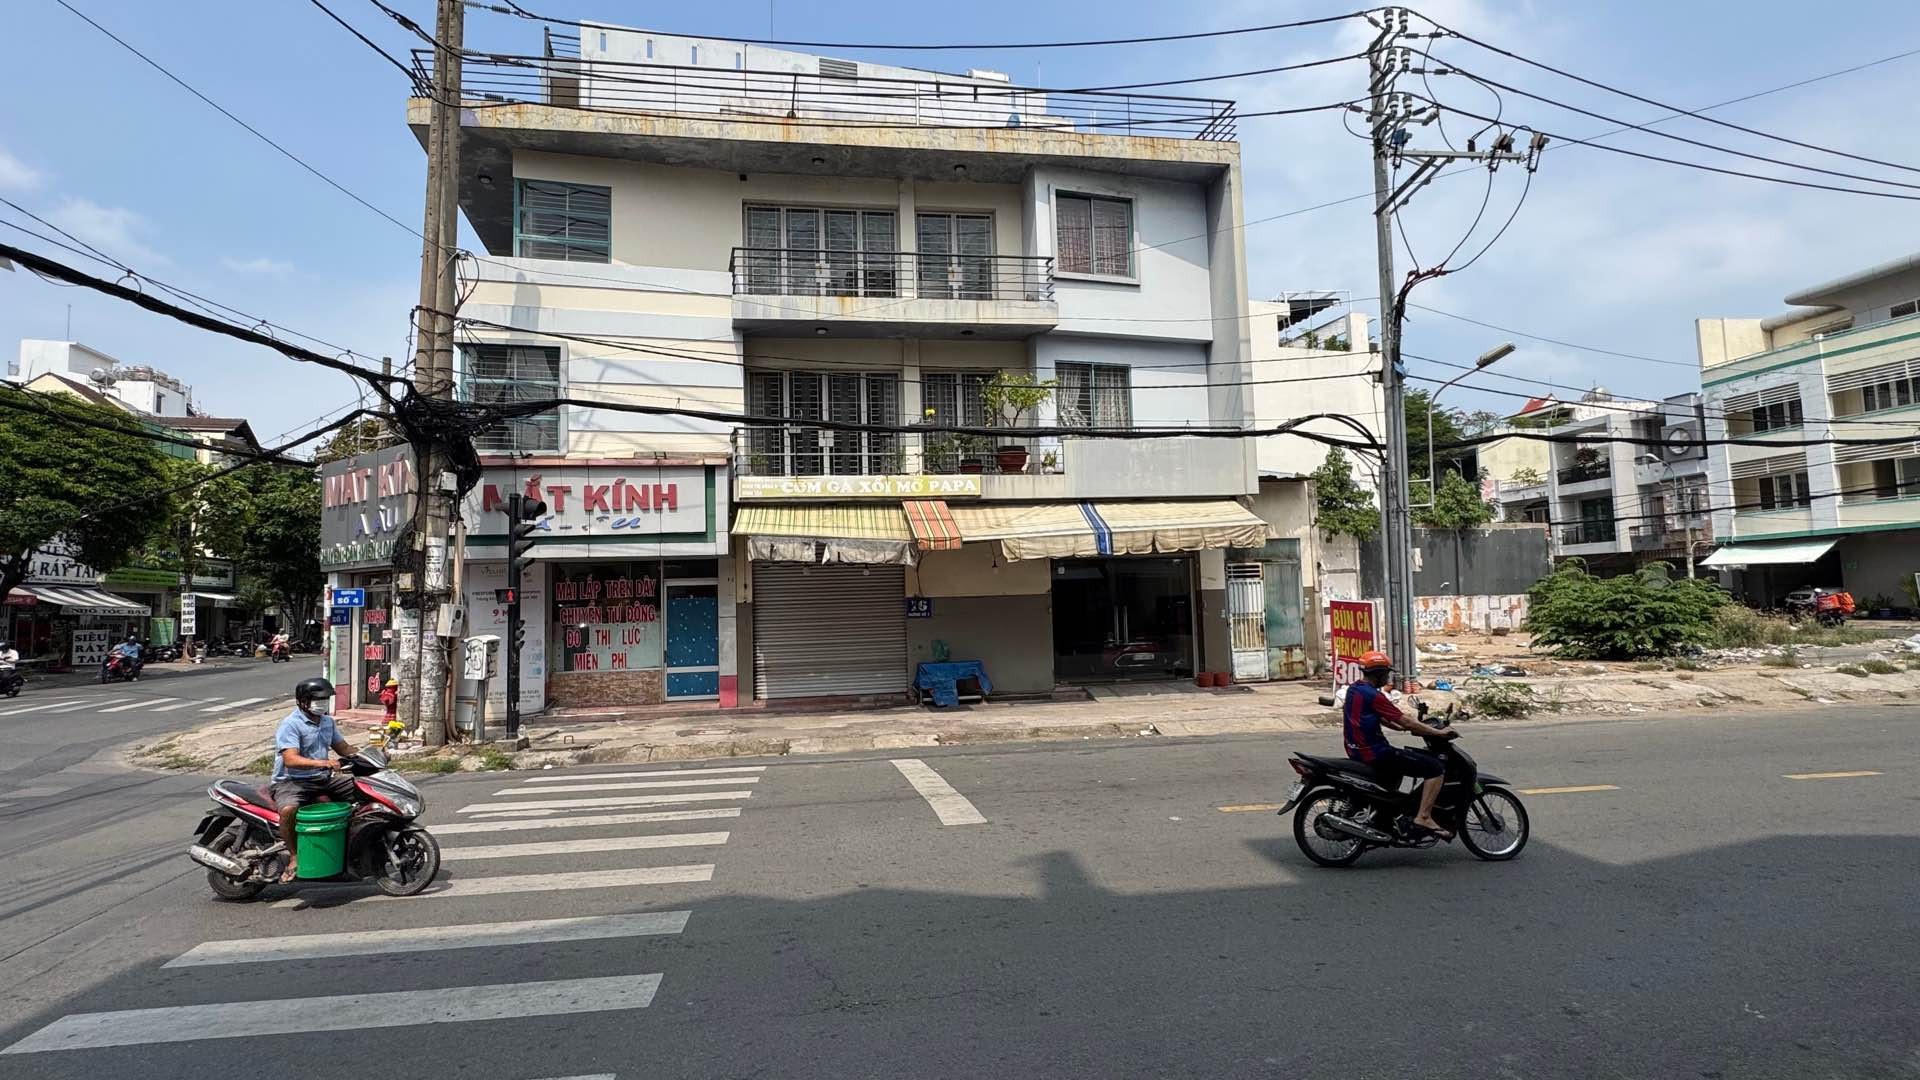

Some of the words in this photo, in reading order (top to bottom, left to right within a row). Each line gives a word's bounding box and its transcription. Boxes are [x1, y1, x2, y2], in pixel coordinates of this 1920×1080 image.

[584, 479, 678, 512] KÍNH
[929, 480, 977, 492] PAPA
[604, 576, 633, 598] TRÊN
[635, 575, 656, 597] DÂY
[1333, 605, 1355, 631] BÚN
[1356, 606, 1371, 633] CÁ
[566, 629, 582, 648] ĐO
[595, 629, 611, 649] THỊ
[611, 648, 628, 669] PHÍ
